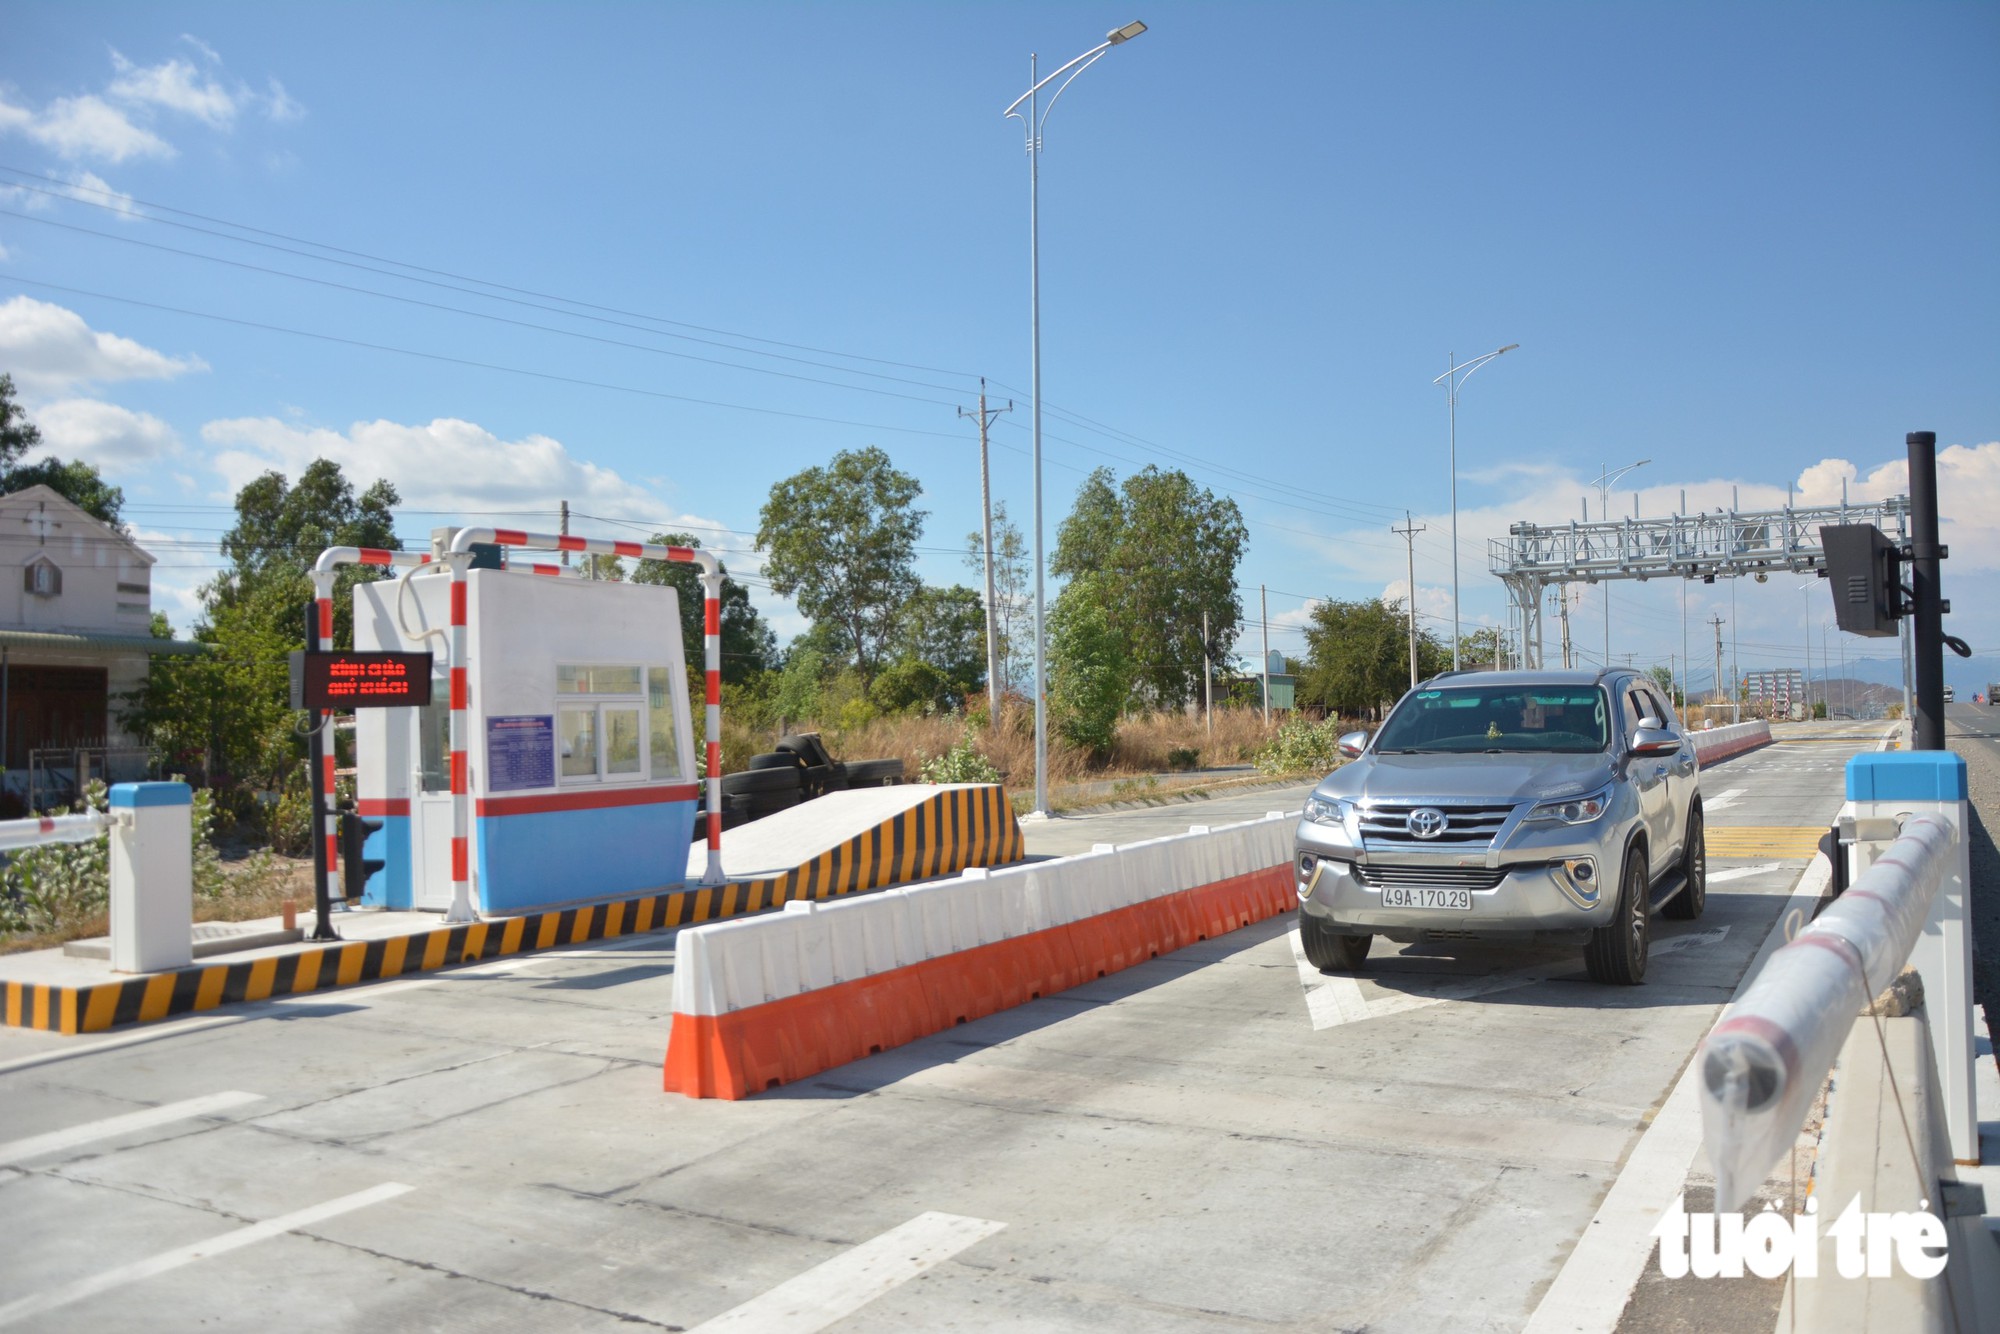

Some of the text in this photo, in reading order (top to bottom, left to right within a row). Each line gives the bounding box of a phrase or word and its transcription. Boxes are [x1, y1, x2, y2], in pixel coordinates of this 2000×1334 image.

[330, 659, 405, 676] KÍNH CHÀO
[328, 677, 408, 695] QUÝ KHÁCH
[1385, 889, 1468, 908] 49A-170.29
